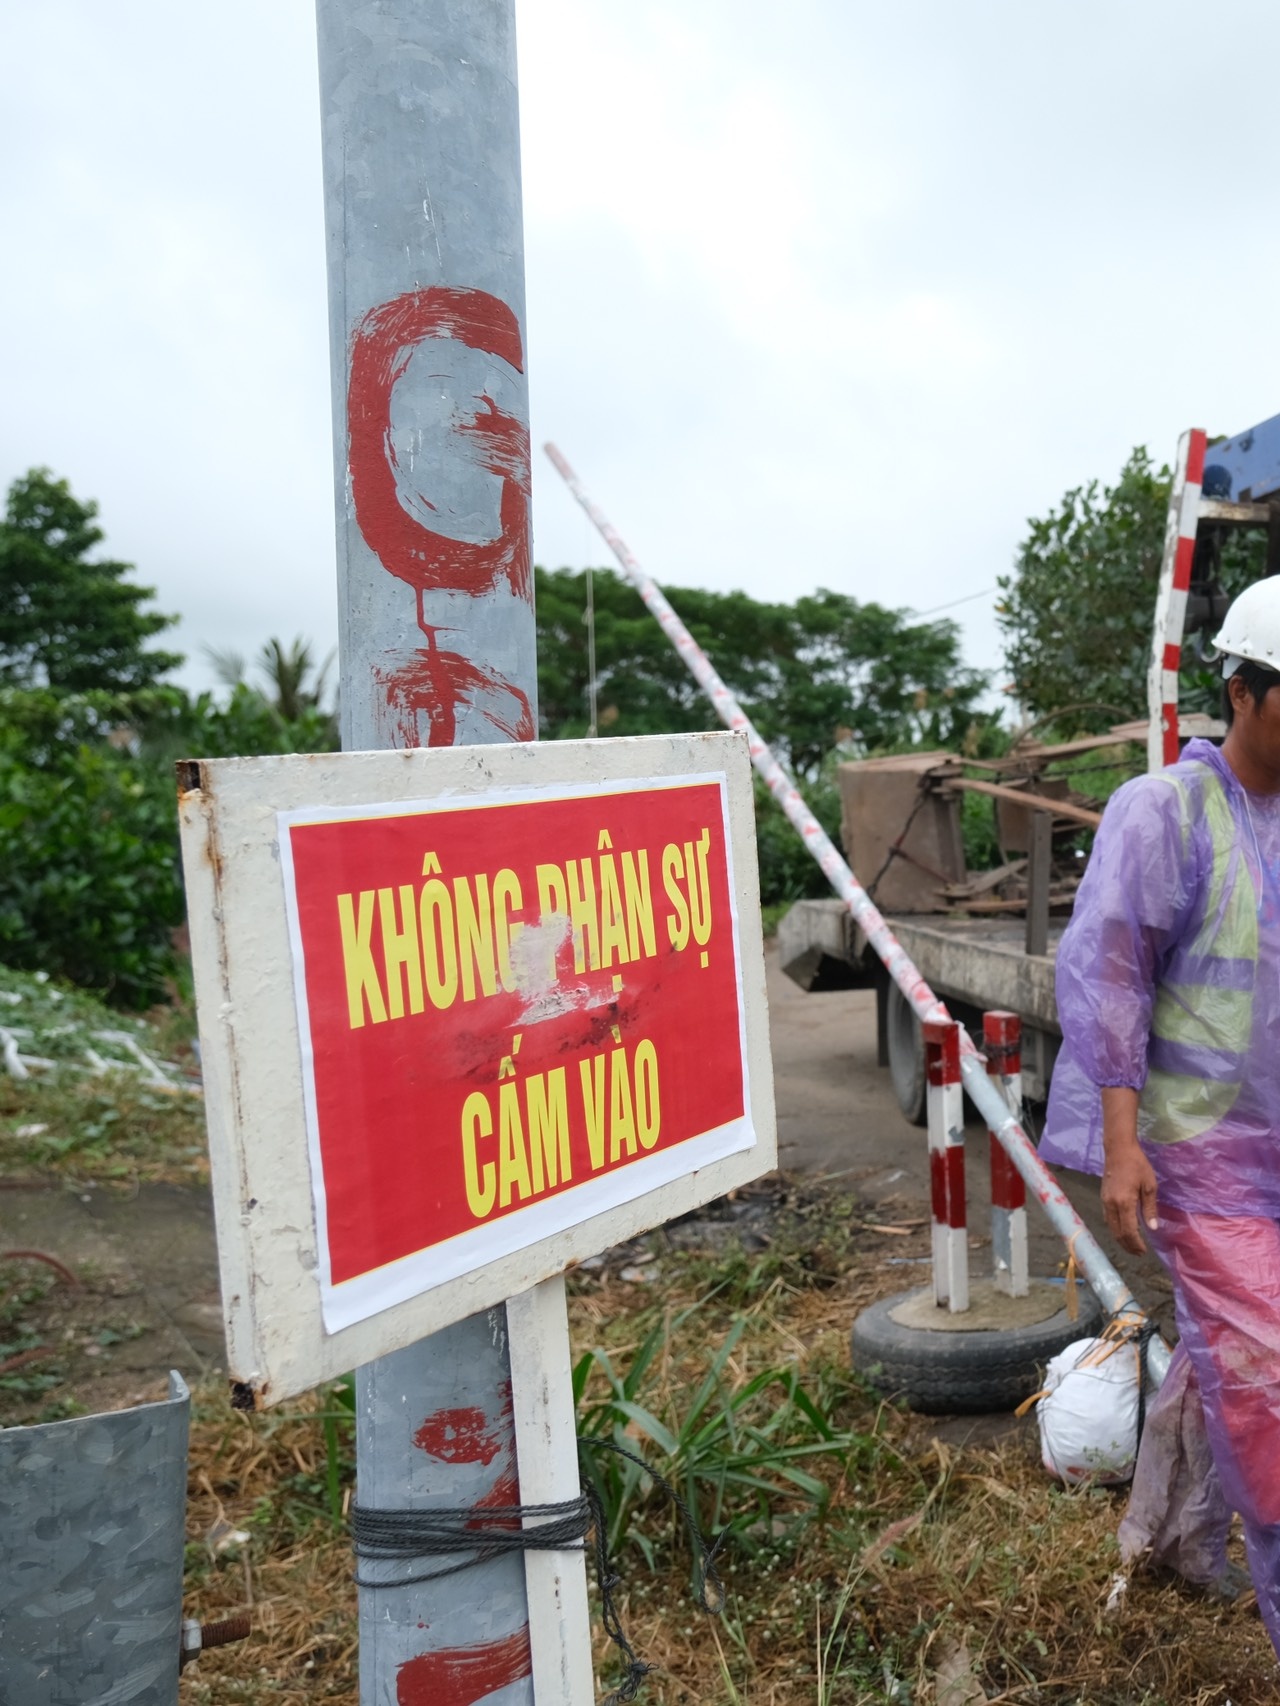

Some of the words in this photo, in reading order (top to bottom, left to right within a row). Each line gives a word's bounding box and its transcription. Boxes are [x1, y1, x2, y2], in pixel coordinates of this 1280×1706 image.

[337, 852, 525, 1029] KHÔNG
[662, 827, 712, 969] SỰ
[461, 1033, 572, 1218] CẤM
[580, 1025, 661, 1171] VÀO
